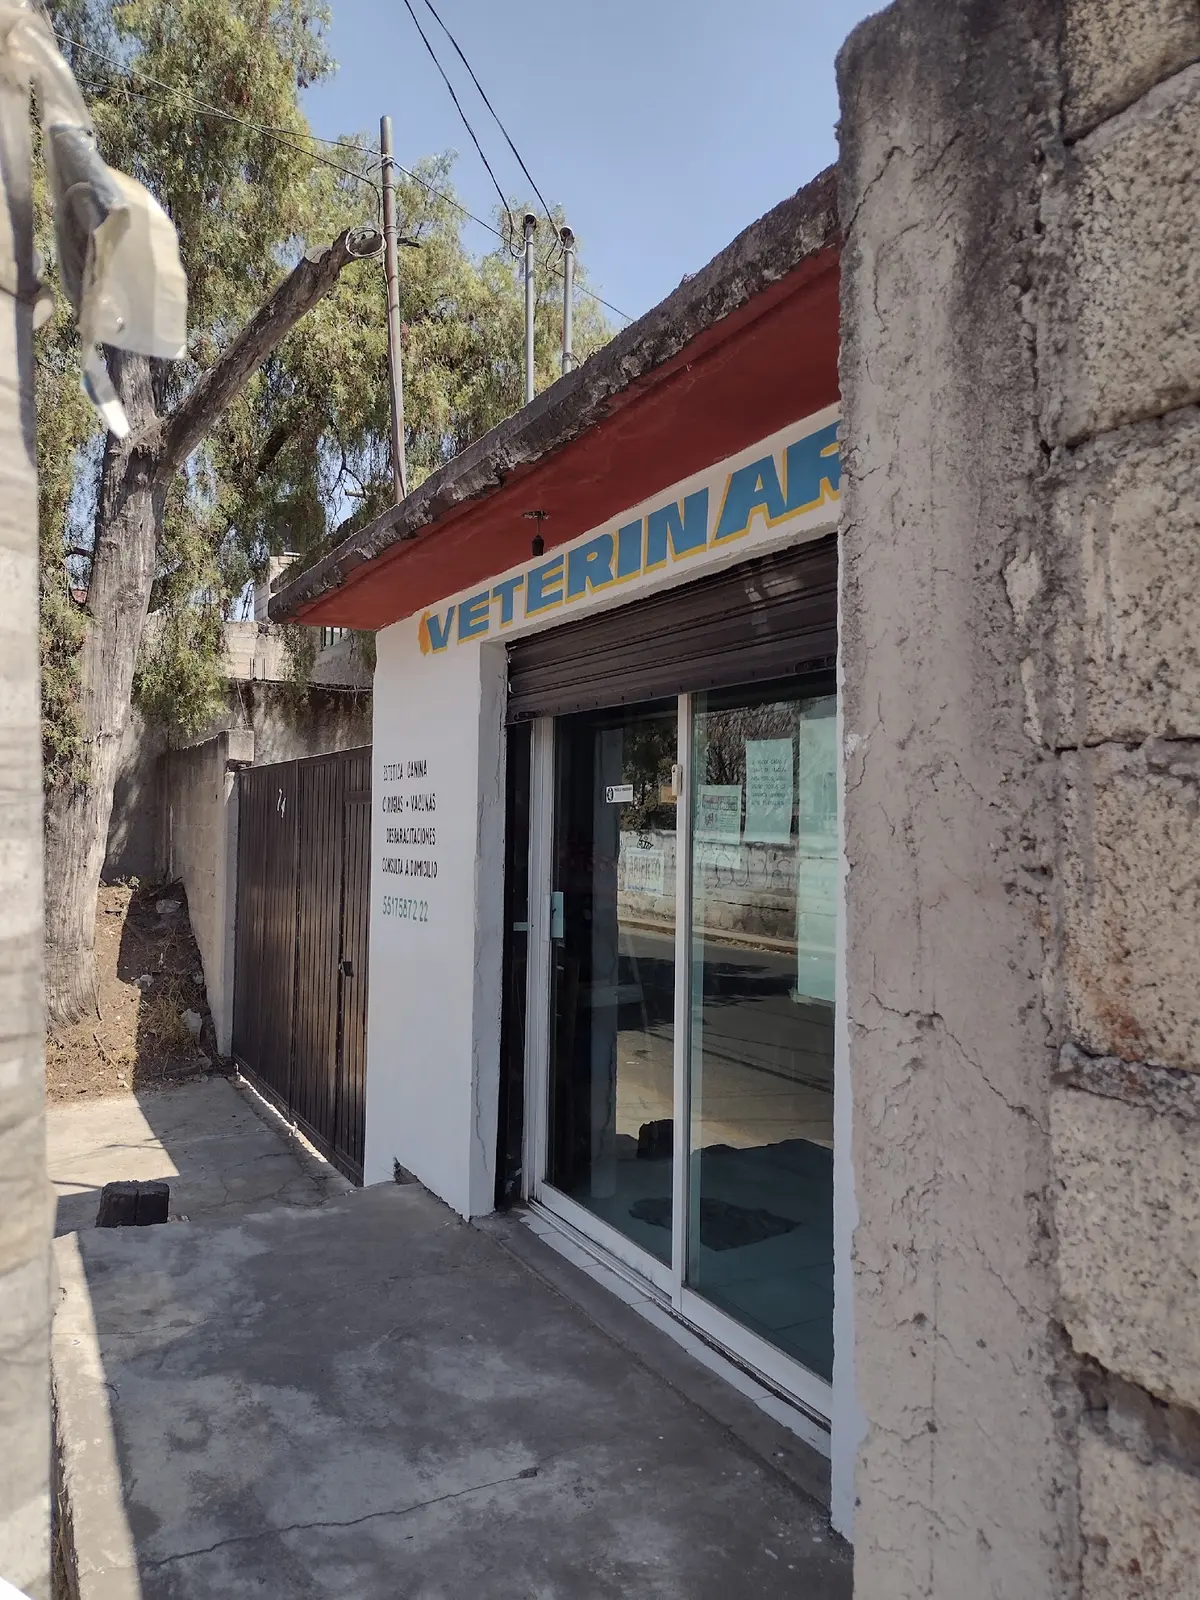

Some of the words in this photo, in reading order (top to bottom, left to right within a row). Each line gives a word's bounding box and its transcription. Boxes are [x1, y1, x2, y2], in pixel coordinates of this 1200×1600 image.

[425, 418, 840, 655] VETERINAR
[407, 759, 428, 779] CANINA
[410, 792, 437, 812] VACUNAS
[382, 857, 404, 876] CONSULTA
[404, 858, 409, 876] A
[410, 860, 438, 879] DOMICILIO
